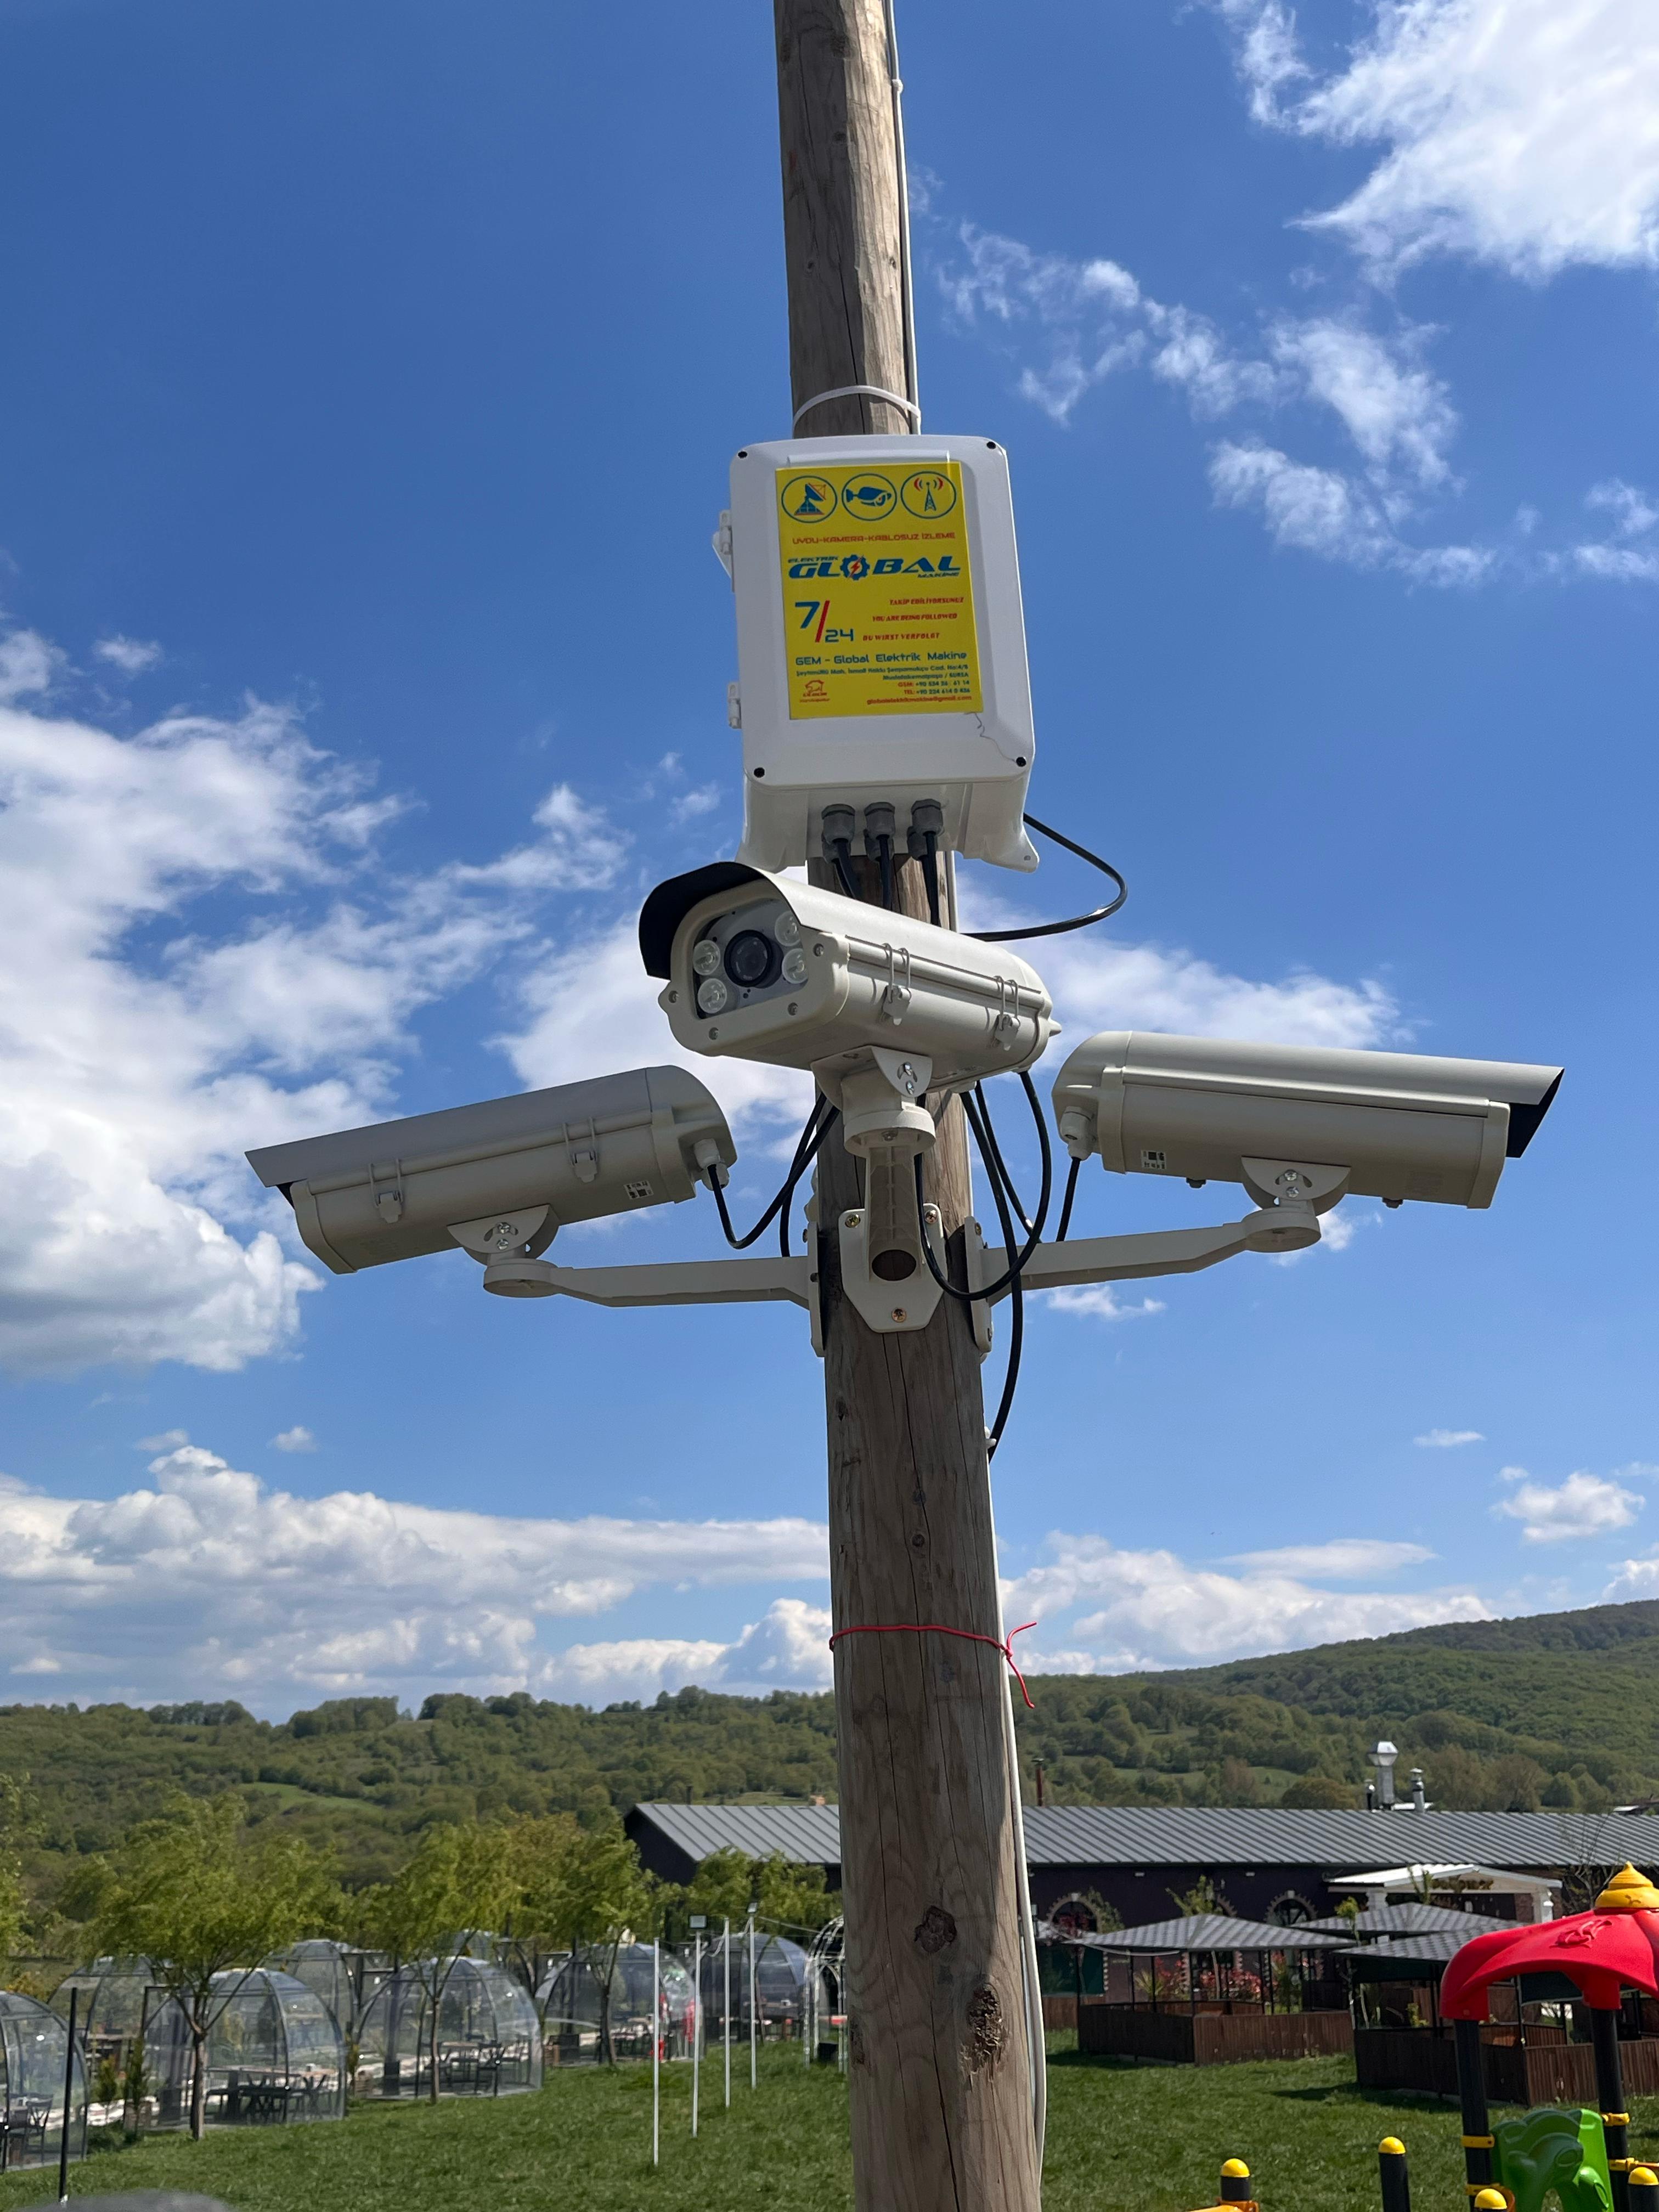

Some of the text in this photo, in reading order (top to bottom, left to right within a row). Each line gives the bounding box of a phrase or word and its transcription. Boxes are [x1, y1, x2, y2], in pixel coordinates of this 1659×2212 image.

[789, 554, 961, 581] GLOBAL
[795, 657, 821, 665] GEM
[834, 654, 869, 664] Global
[876, 652, 921, 662] Elektrik
[928, 651, 967, 660] Makine
